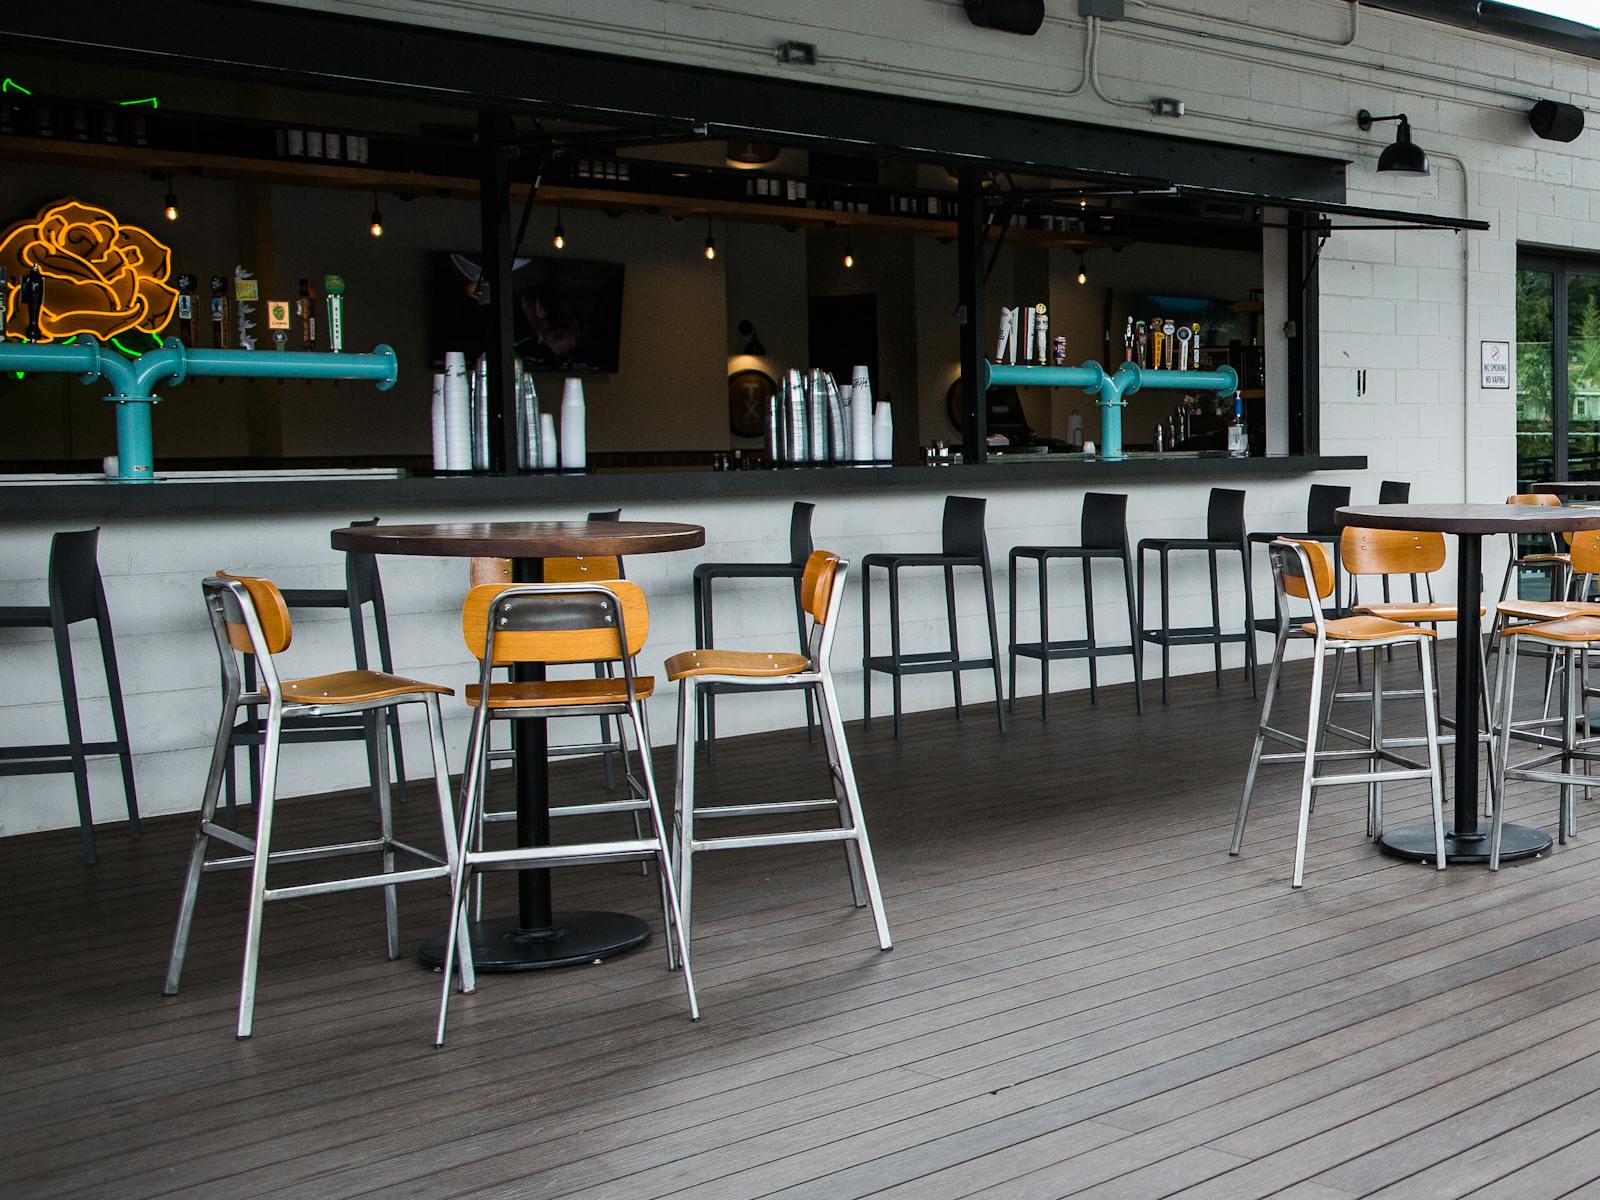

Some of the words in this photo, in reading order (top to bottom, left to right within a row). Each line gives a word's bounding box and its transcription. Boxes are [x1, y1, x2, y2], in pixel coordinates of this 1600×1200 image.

[1484, 363, 1490, 372] NO
[1491, 363, 1507, 372] SMOKING
[1486, 375, 1491, 384] NO
[1492, 375, 1506, 384] VAPING
